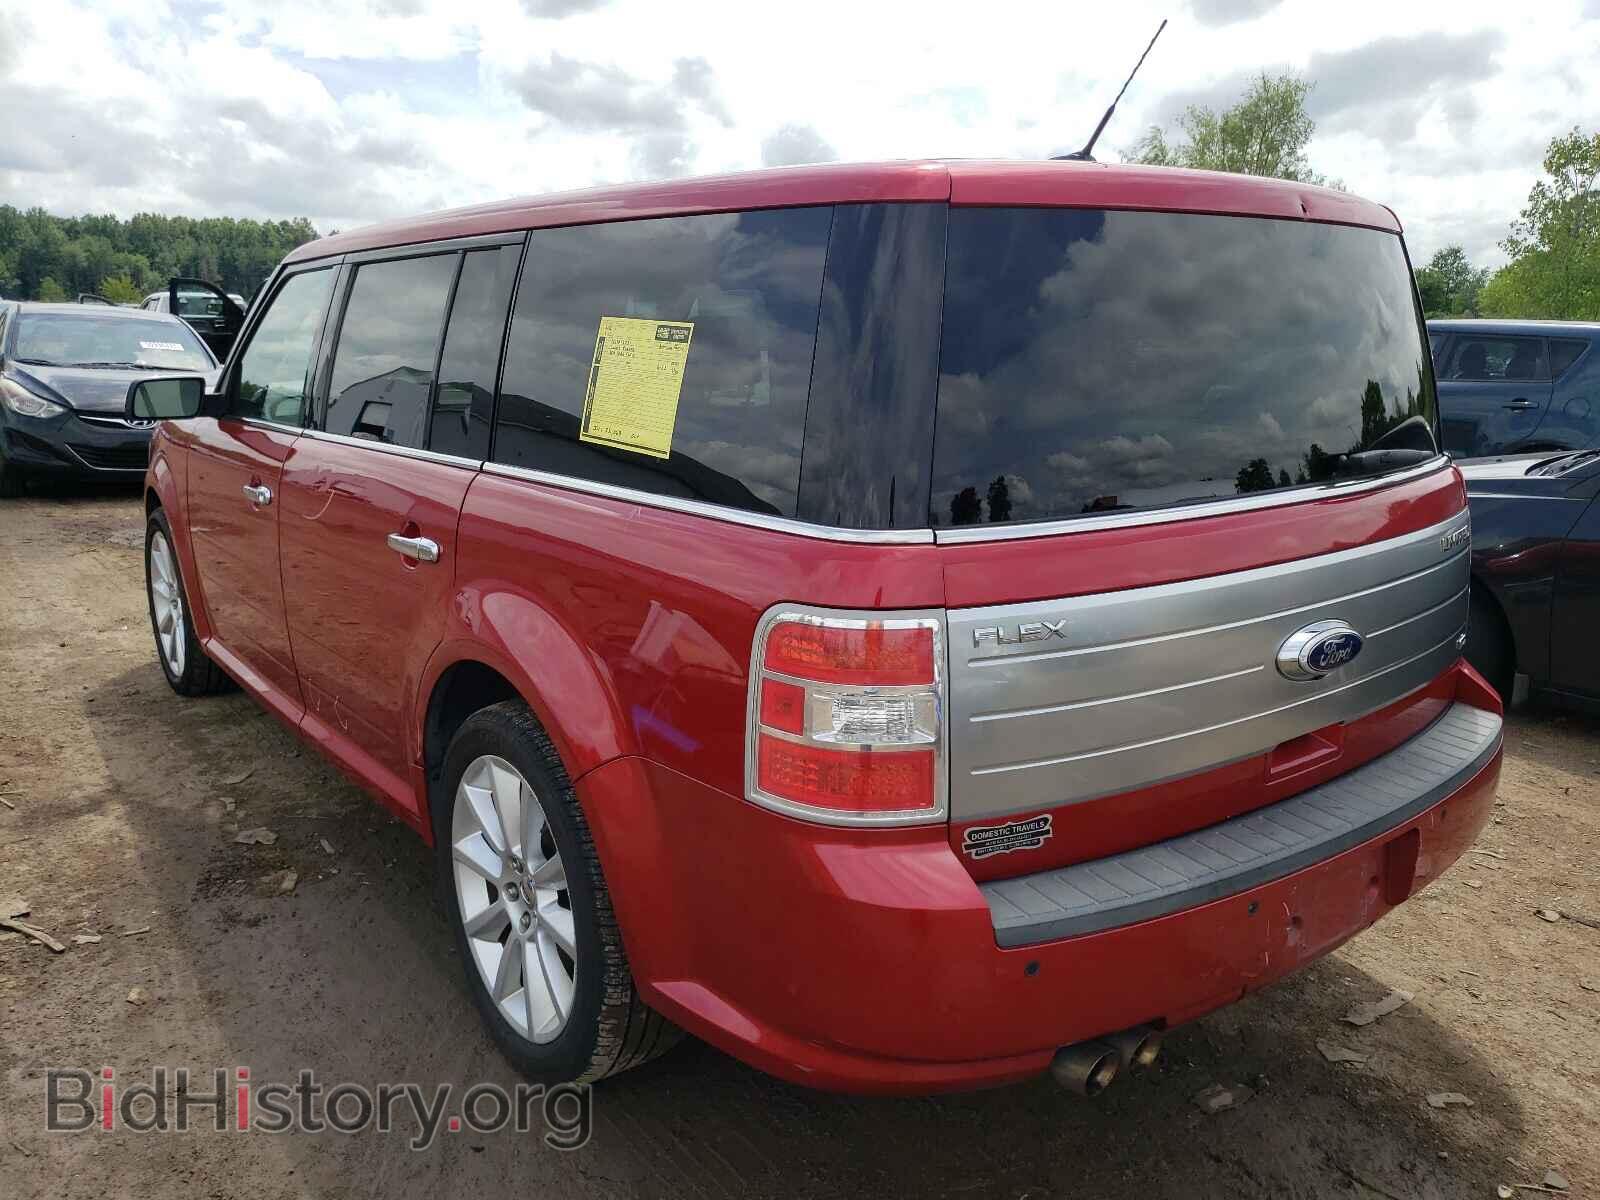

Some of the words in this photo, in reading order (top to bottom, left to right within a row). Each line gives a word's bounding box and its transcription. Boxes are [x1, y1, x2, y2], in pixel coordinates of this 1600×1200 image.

[972, 618, 1067, 649] FLEX
[1319, 636, 1353, 667] Ford
[971, 827, 1011, 841] DOMESTIC
[1012, 820, 1046, 834] TRAVELS
